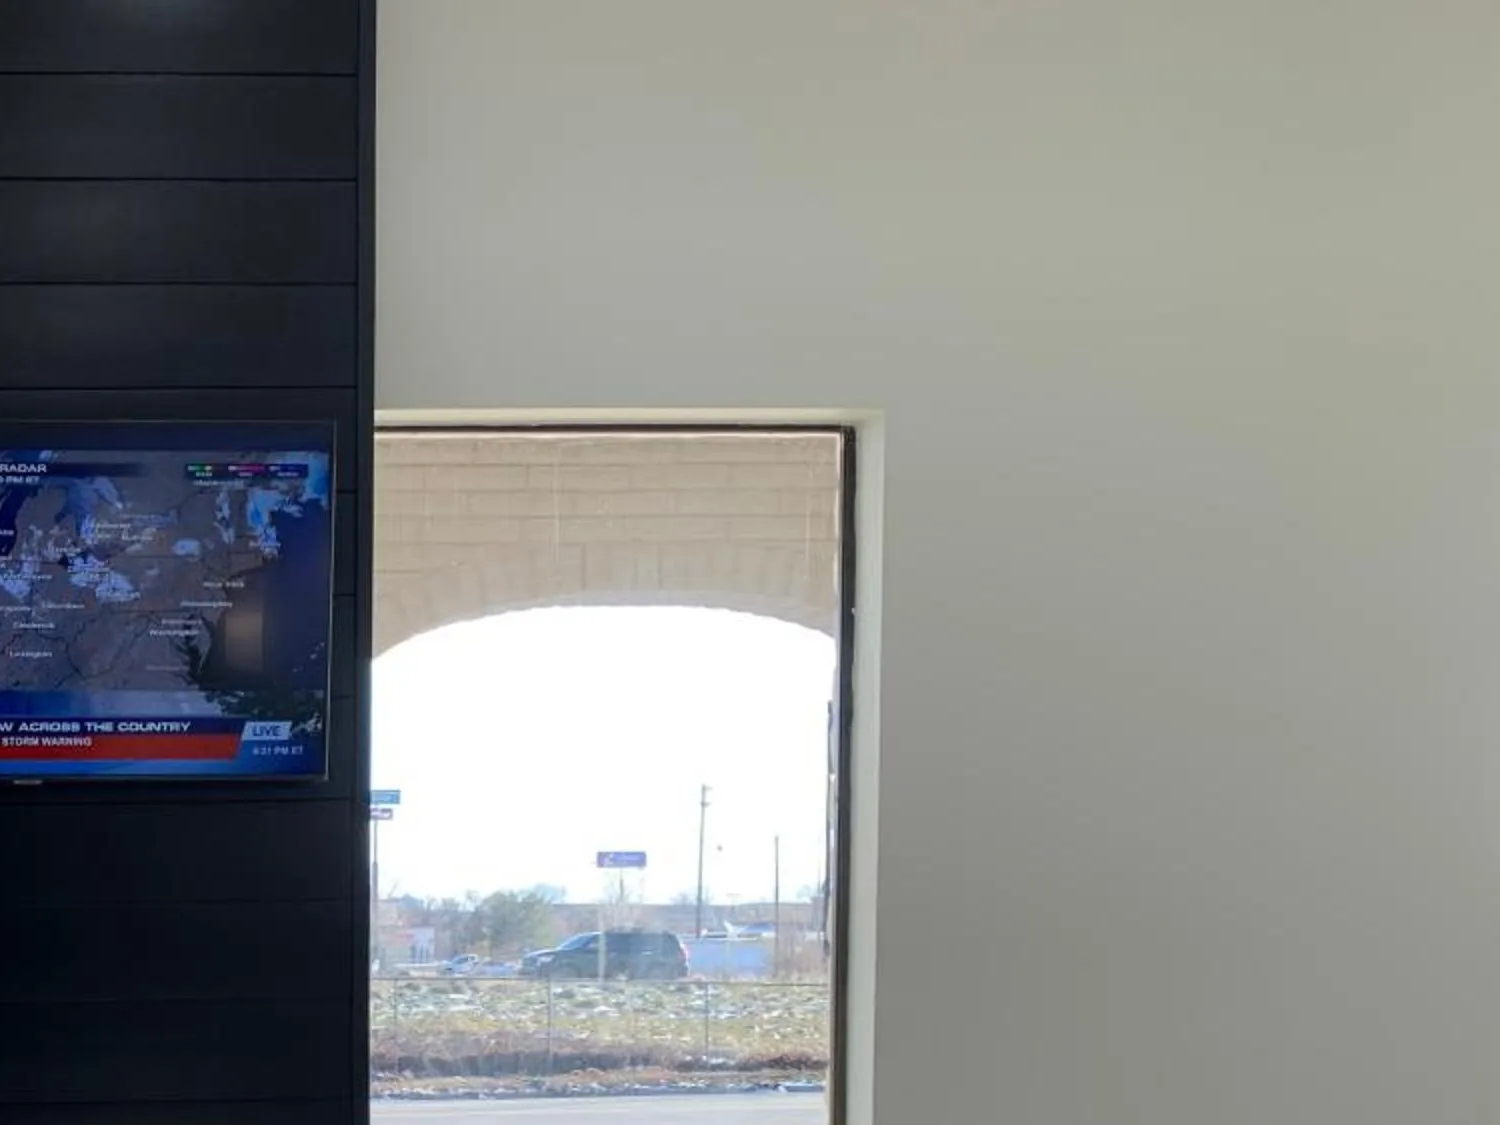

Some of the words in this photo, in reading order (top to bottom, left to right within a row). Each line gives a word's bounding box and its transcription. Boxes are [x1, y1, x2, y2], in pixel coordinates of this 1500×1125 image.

[0, 463, 47, 473] RADAR
[18, 721, 81, 733] ACROSS
[84, 721, 113, 733] THE
[116, 721, 191, 733] COUNTRY
[252, 725, 282, 737] LIVE
[1, 736, 40, 747] STORM
[41, 736, 92, 748] WARNING
